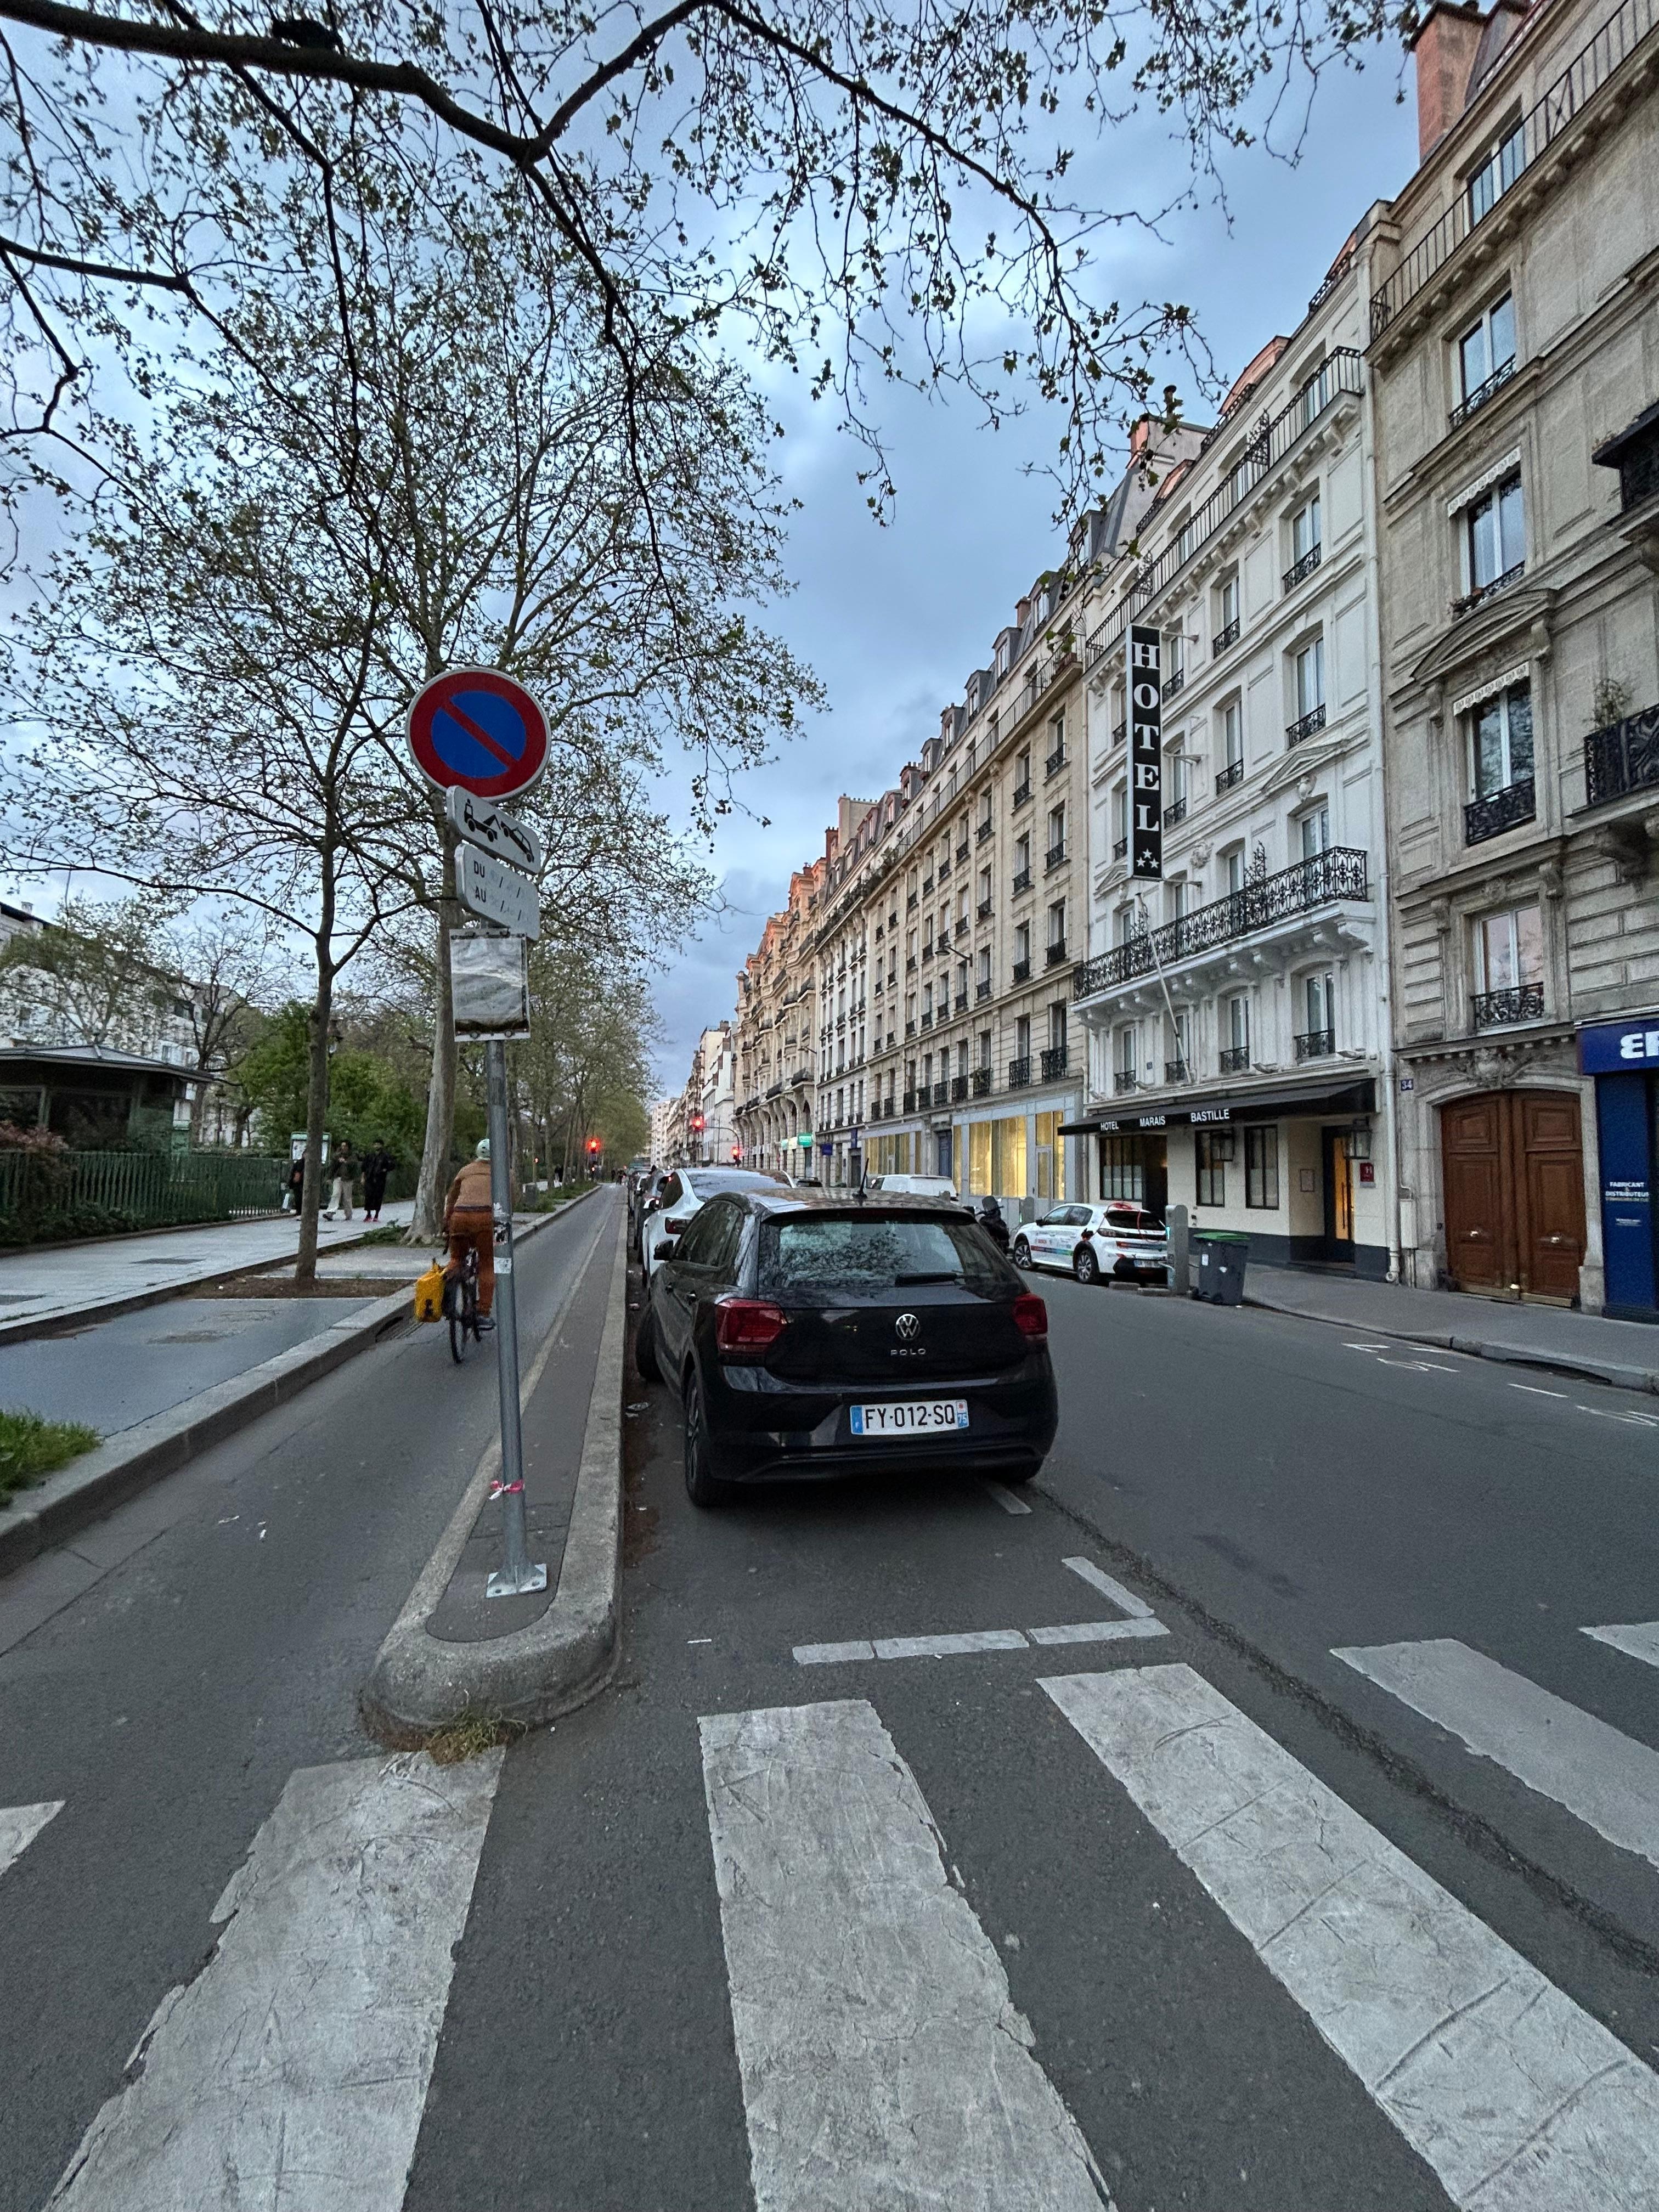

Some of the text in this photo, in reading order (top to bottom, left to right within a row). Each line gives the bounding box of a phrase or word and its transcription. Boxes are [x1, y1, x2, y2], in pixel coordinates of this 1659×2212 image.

[1132, 641, 1160, 832] HOTEL
[473, 860, 485, 878] DU
[475, 886, 486, 903] AU
[1402, 1080, 1413, 1090] 34
[1100, 1108, 1230, 1131] HOTEL MARAIS BASTILLE
[890, 1348, 926, 1356] POLO
[957, 1413, 968, 1424] 75
